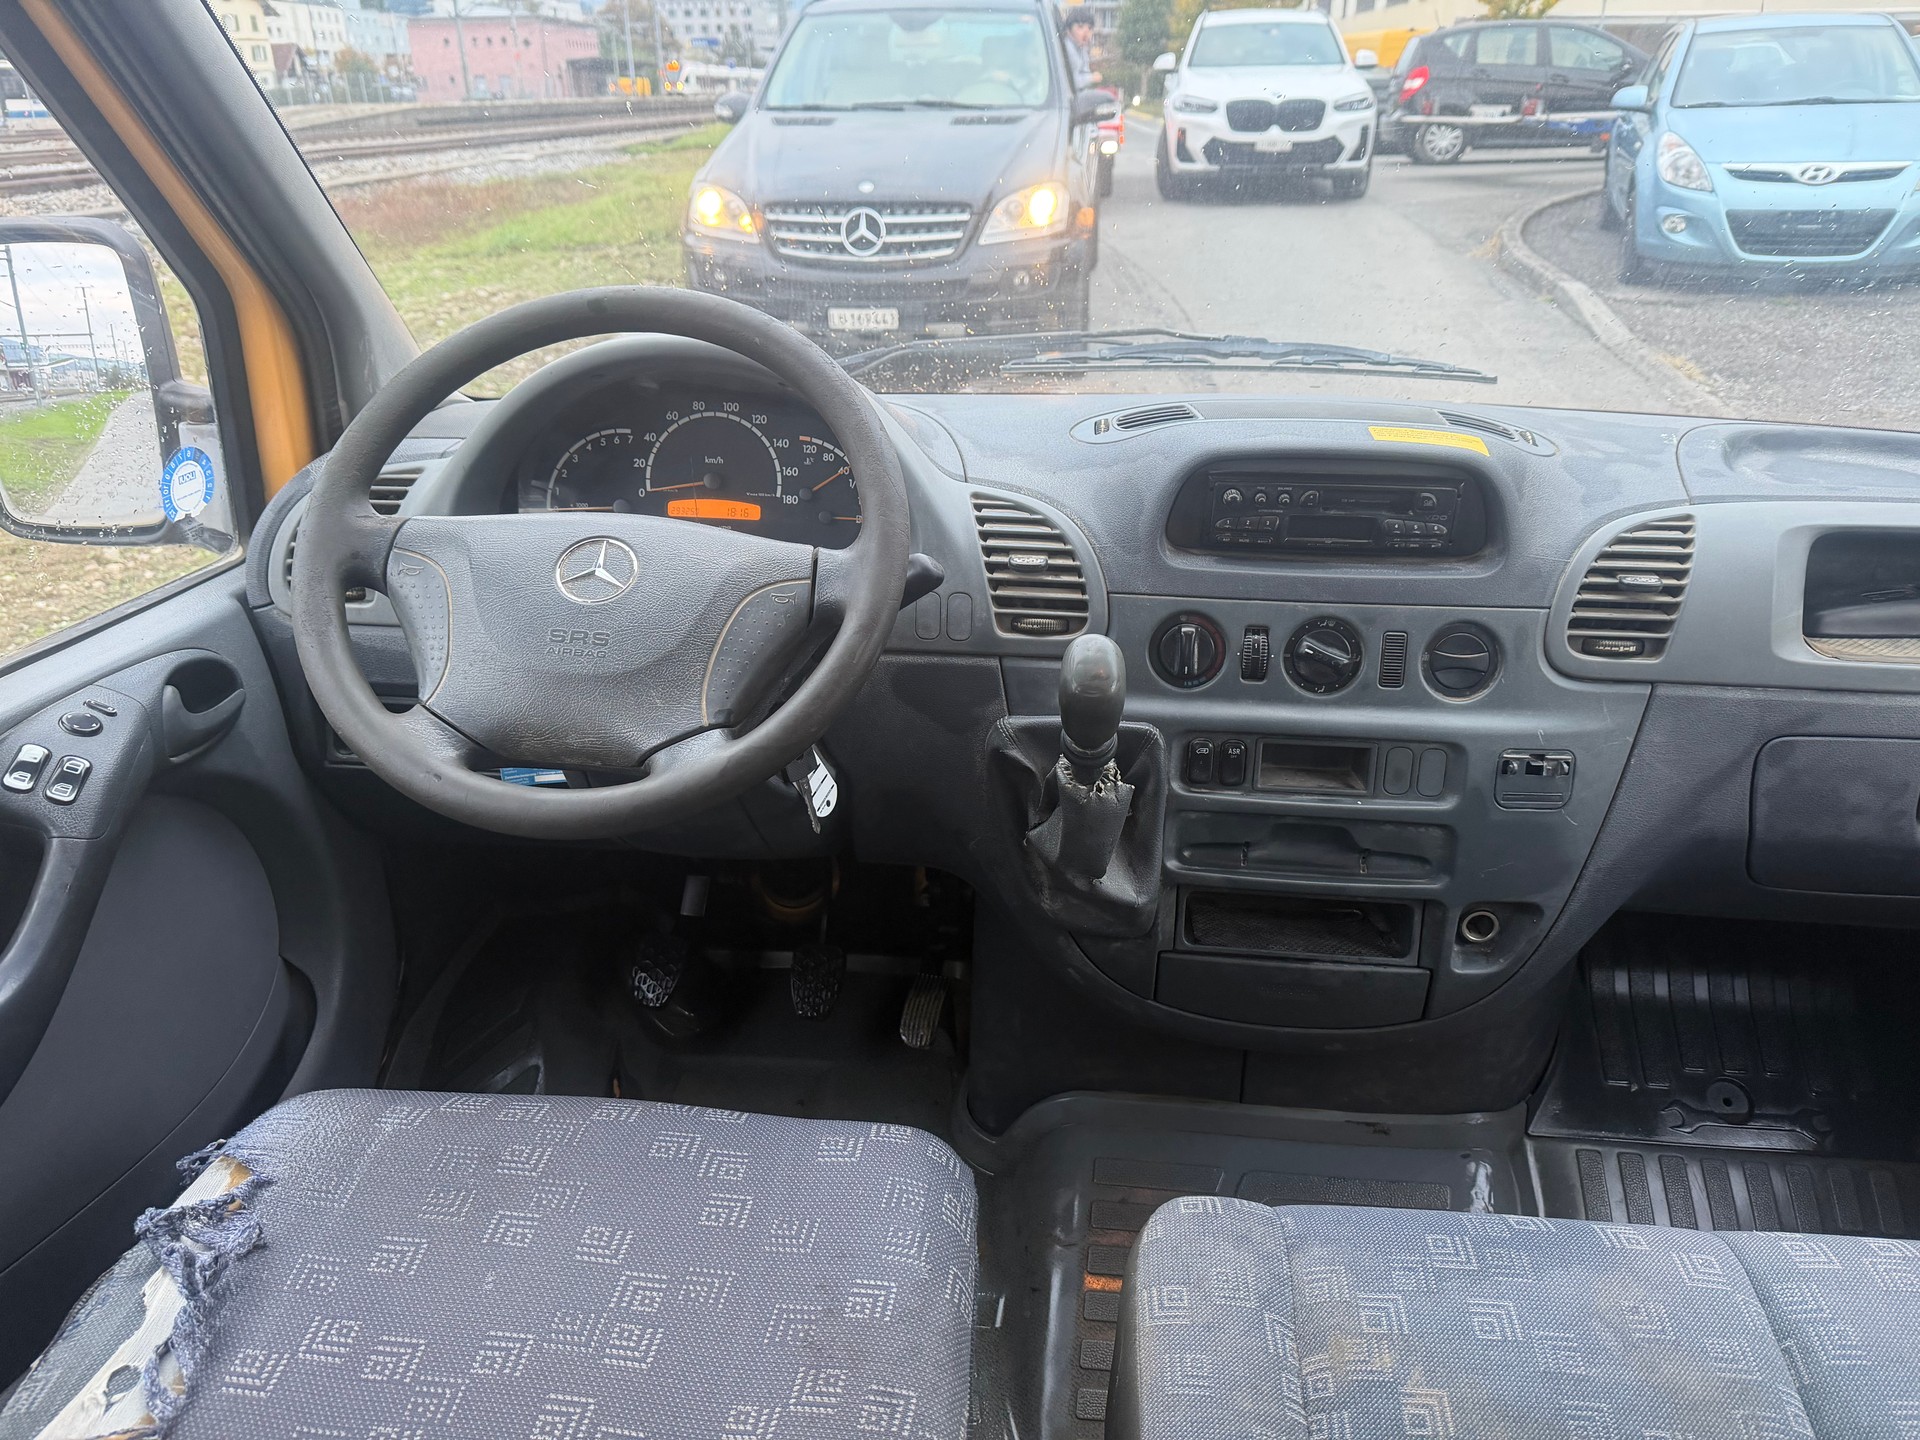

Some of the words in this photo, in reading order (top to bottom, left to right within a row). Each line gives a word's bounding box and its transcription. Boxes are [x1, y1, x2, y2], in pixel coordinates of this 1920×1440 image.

[692, 401, 706, 411] 80
[722, 402, 740, 412] 100
[665, 410, 679, 421] 60
[751, 414, 768, 425] 120
[600, 437, 607, 447] 5
[613, 436, 620, 445] 6
[627, 435, 634, 444] 7
[643, 432, 657, 442] 40
[586, 442, 592, 452] 4
[772, 438, 790, 449] 140
[802, 445, 817, 454] 120
[572, 454, 579, 463] 3
[704, 455, 724, 465] km/h
[822, 452, 835, 462] 80
[632, 458, 646, 468] 20
[561, 469, 568, 478] 2
[781, 466, 799, 477] 160
[838, 466, 850, 475] 40
[555, 487, 560, 496] 1
[638, 488, 646, 498] 0
[781, 494, 799, 505] 180
[548, 628, 611, 647] SRS
[545, 646, 607, 659] AIRBAG
